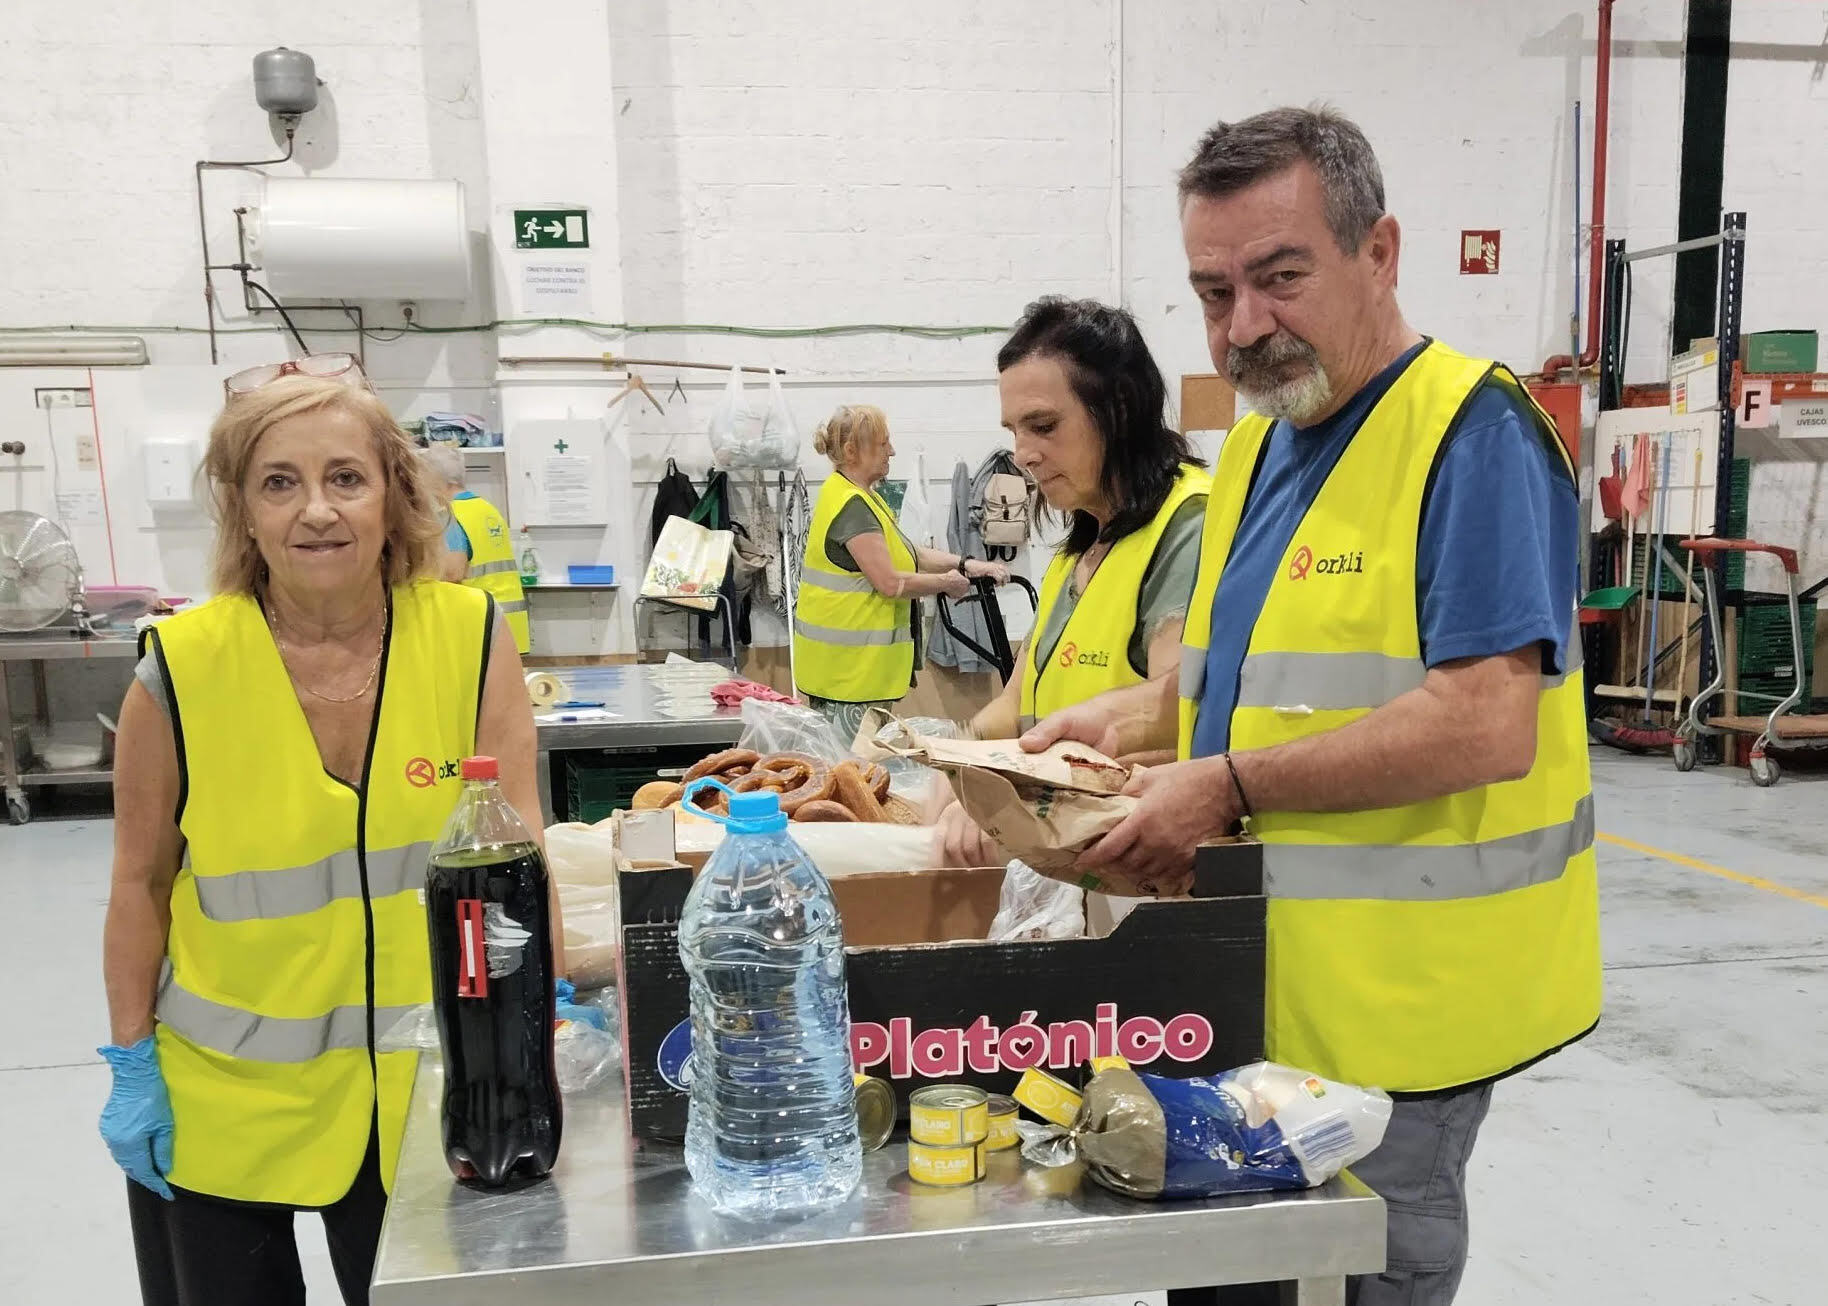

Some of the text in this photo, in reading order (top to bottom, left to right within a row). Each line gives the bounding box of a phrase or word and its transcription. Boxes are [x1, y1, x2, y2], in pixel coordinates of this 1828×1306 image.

[1744, 390, 1761, 422] F
[1800, 408, 1824, 416] CAJAS
[1796, 418, 1827, 426] UVESCO
[1315, 551, 1363, 575] orkli
[1078, 650, 1109, 668] orkli
[850, 1003, 1214, 1080] Platónico
